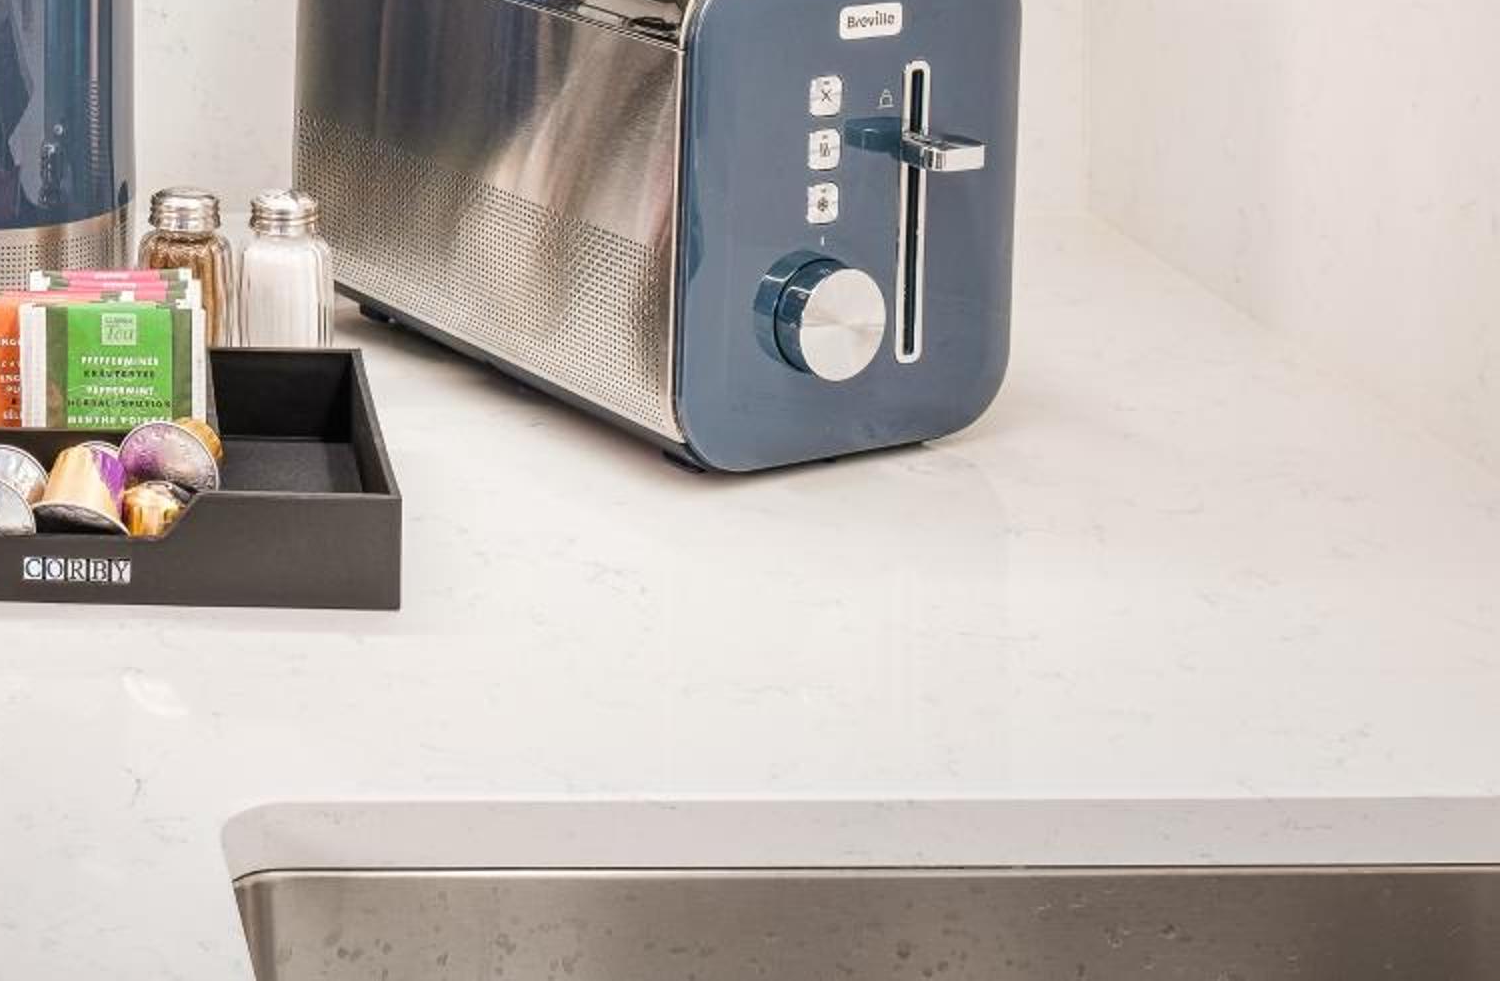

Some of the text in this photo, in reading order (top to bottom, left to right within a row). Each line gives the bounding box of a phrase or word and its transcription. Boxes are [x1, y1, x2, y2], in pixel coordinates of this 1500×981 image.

[847, 10, 895, 28] Breville
[86, 386, 154, 396] PEPPERMINT
[24, 557, 130, 581] CORBY
